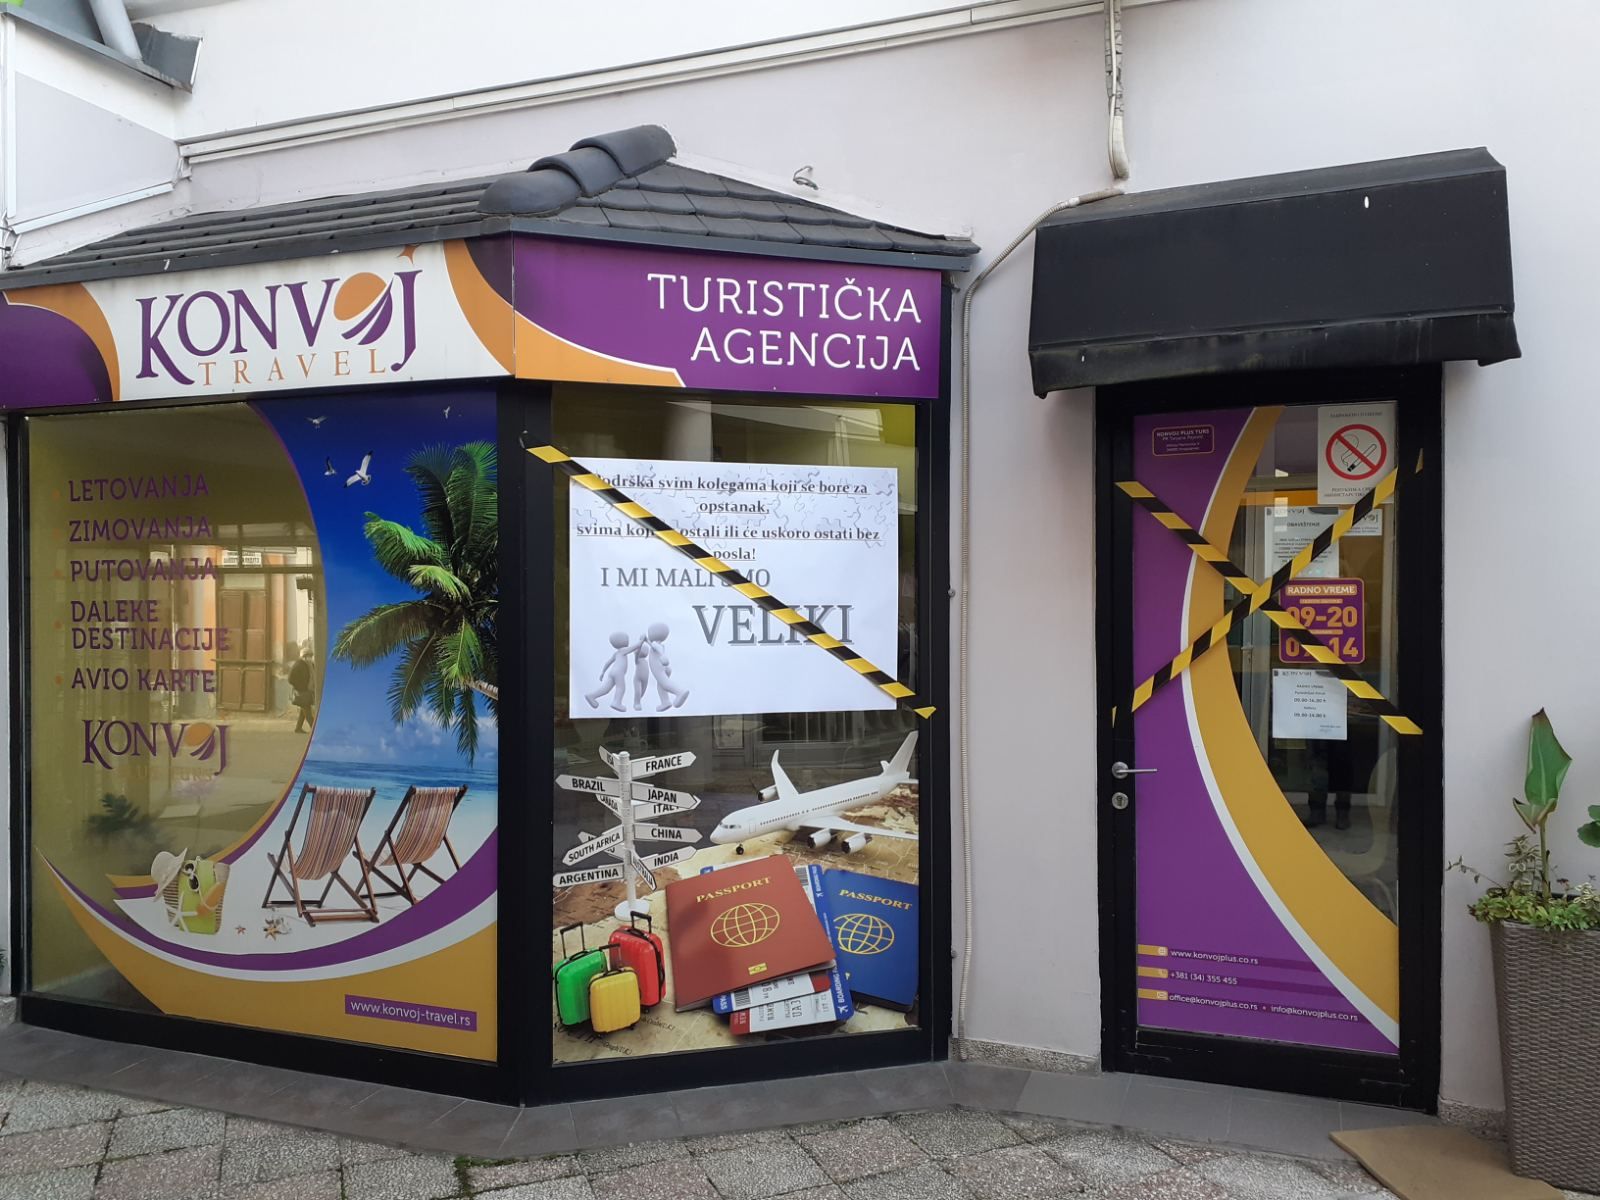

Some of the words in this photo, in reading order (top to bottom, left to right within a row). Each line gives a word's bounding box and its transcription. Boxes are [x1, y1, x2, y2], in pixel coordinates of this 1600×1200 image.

[648, 273, 921, 323] TURISTIČKA
[136, 269, 423, 385] KONVOJ
[690, 327, 920, 371] AGENCIJA
[198, 349, 386, 387] TRAVEL
[68, 473, 210, 502] LETOVANJA
[597, 474, 654, 488] odrška
[659, 476, 693, 490] svim
[698, 476, 767, 494] kolegama
[771, 478, 799, 495] koji
[801, 482, 815, 493] se
[819, 481, 850, 494] bore
[853, 484, 868, 494] za
[700, 501, 770, 514] opstanak,
[69, 516, 211, 542] ZIMOVANJA
[577, 523, 621, 536] svima
[680, 525, 720, 538] ostali
[724, 525, 739, 538] ili
[743, 526, 758, 539] će
[762, 527, 810, 540] uskoro
[814, 528, 852, 541] ostati
[856, 528, 880, 541] bez
[714, 548, 756, 560] posla!
[70, 557, 217, 582] PUTOVANJA
[601, 568, 609, 587] I
[616, 568, 648, 587] MI
[656, 568, 715, 588] MALI
[1287, 585, 1321, 594] RADNO
[1323, 584, 1356, 594] VREME
[71, 600, 159, 623] DALEKE
[71, 627, 231, 651] DESTINACIJE
[71, 668, 129, 690] AVIO
[138, 669, 216, 693] KARTE
[82, 719, 232, 776] KONVOJ
[645, 755, 683, 772] FRANCE
[571, 778, 605, 792] BRAZIL
[648, 788, 677, 804] JAPAN
[651, 828, 682, 840] CHINA
[568, 843, 595, 862] SOUTH
[595, 832, 621, 850] AFRICA
[653, 852, 679, 867] INDIA
[559, 868, 619, 885] ARGENTINA
[695, 876, 772, 903] PASSPORT
[839, 889, 912, 911] PASSPORT
[1170, 950, 1259, 966] www.konvojplus.co.rs
[1170, 971, 1188, 980] +381
[1190, 972, 1205, 982] (34)
[1207, 974, 1221, 984] 355
[1223, 975, 1238, 985] 455
[350, 1001, 471, 1026] www.konvoj-travel.rs
[1169, 993, 1258, 1011] office@konvojplus.co.rs
[1271, 1004, 1358, 1022] info@konvojplus.co.rs
